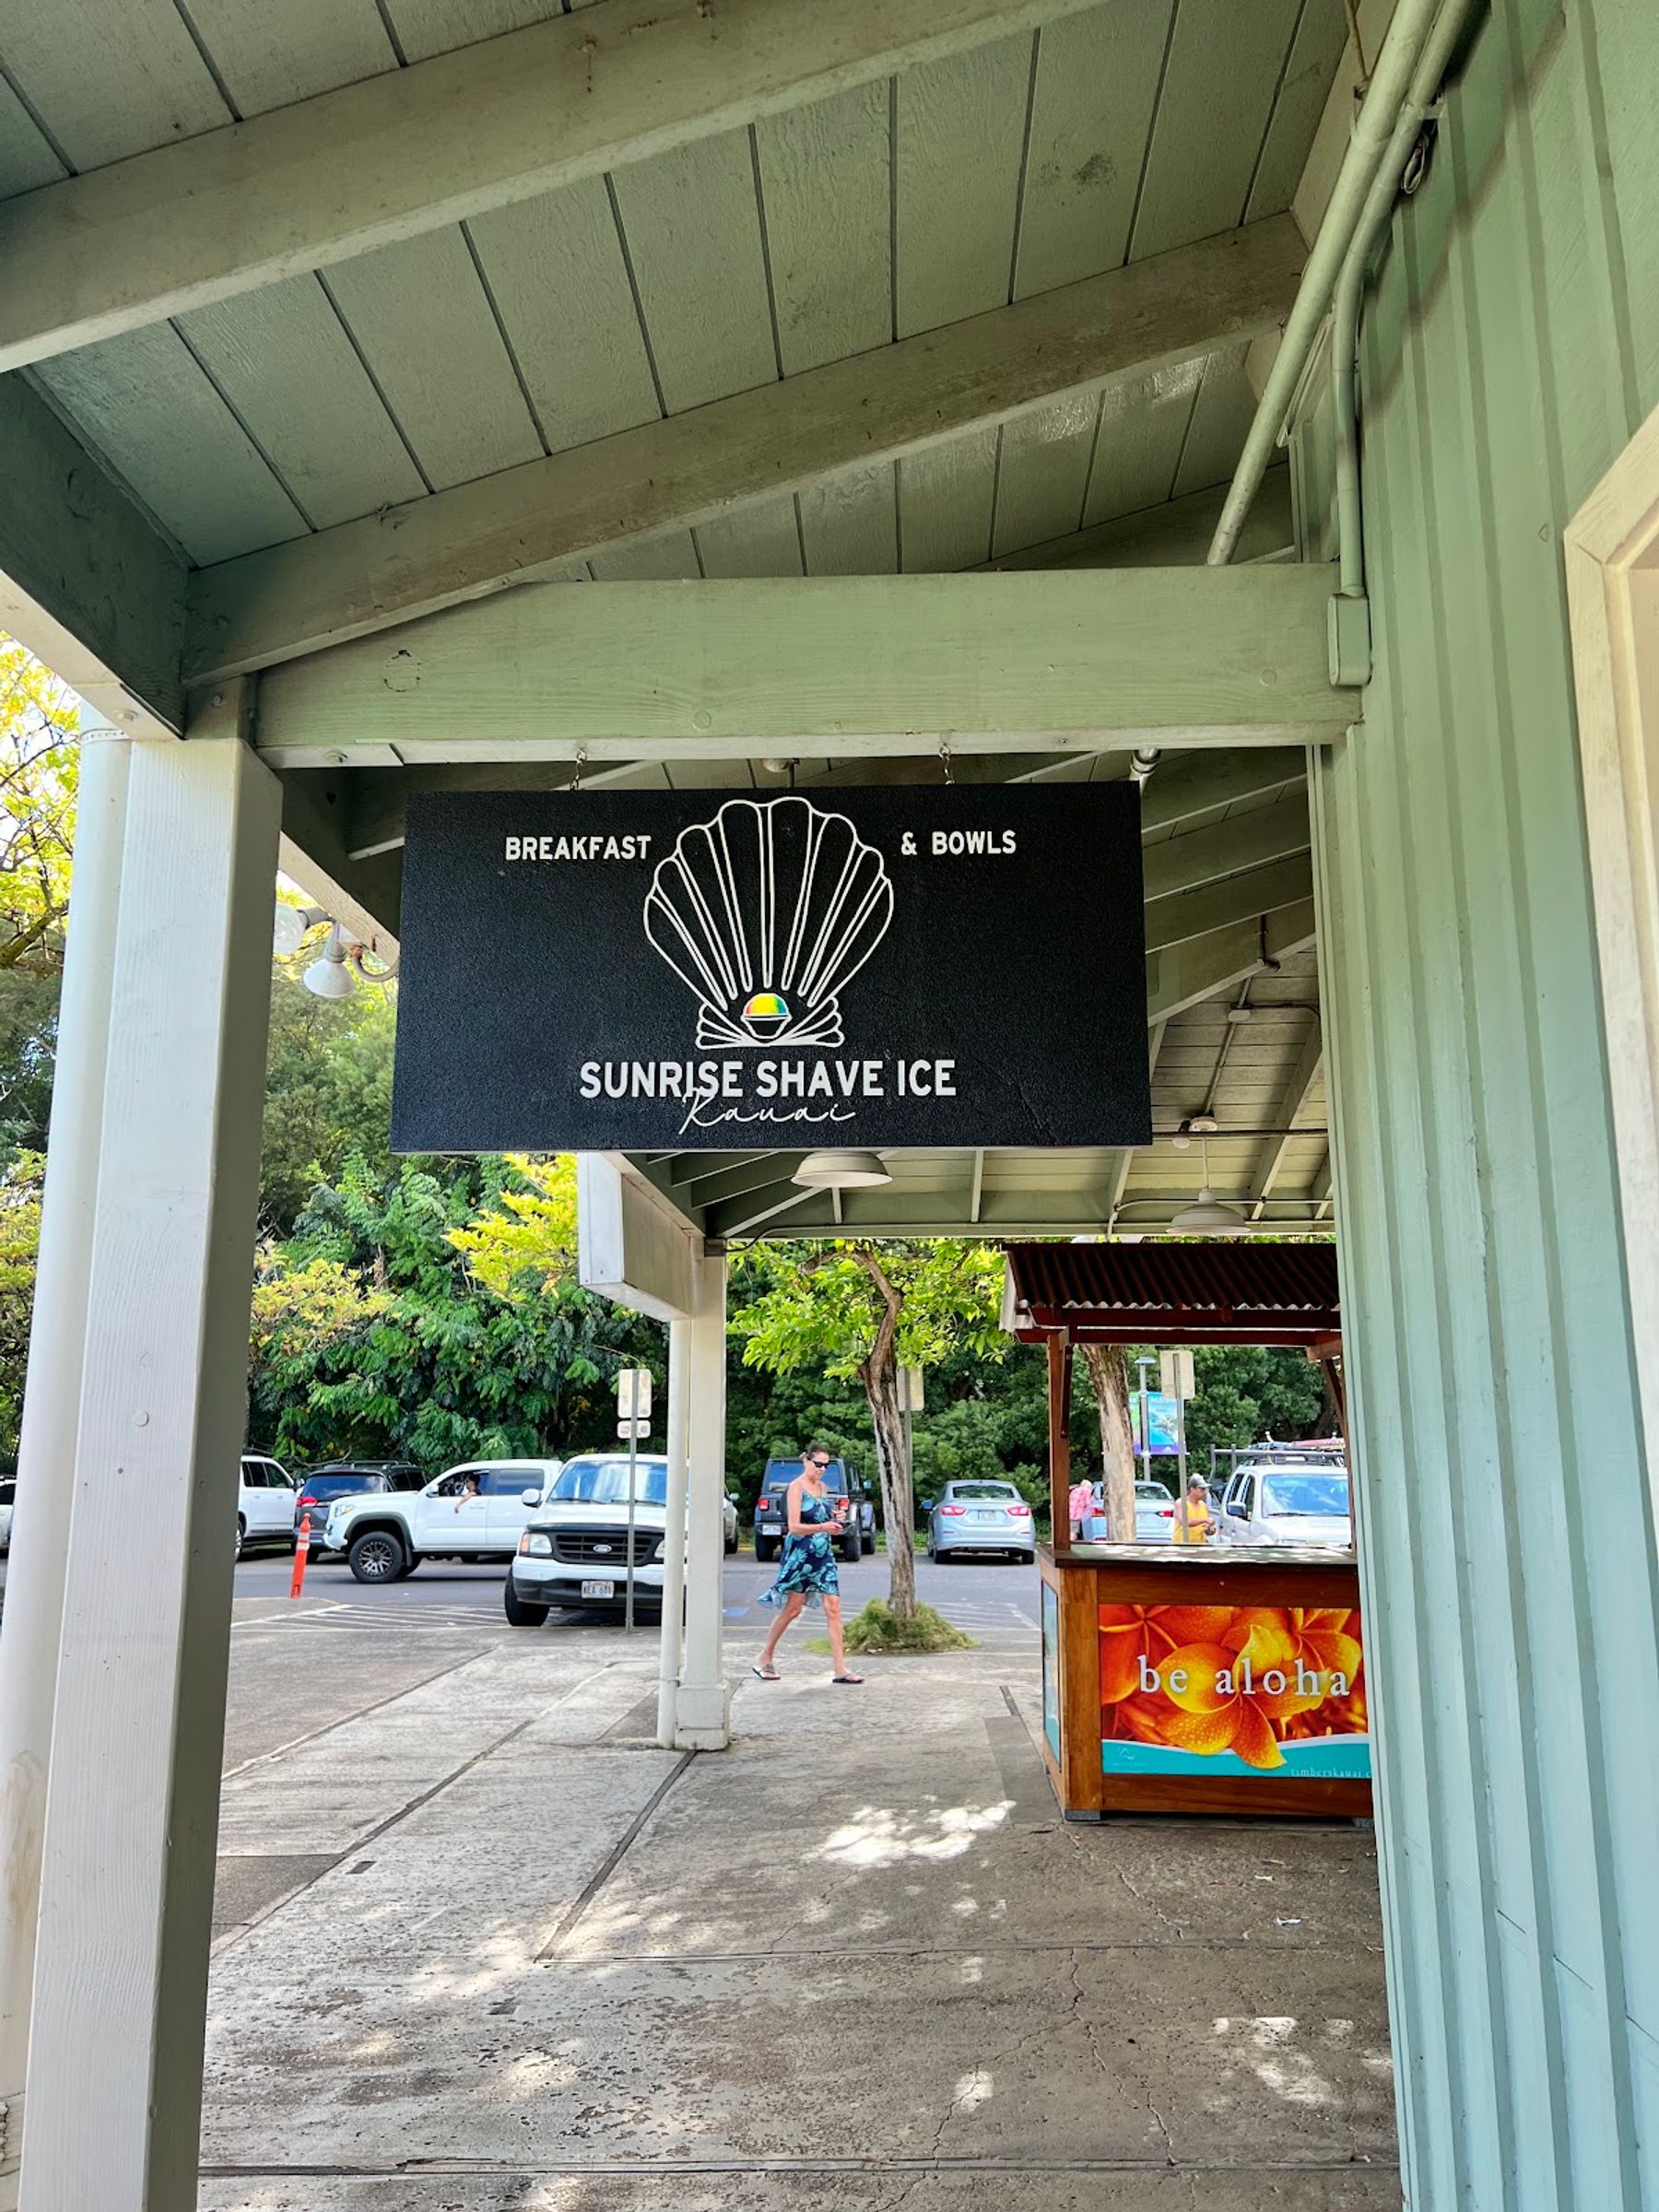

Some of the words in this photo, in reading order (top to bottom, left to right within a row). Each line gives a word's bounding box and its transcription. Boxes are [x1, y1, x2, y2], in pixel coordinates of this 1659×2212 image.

[505, 835, 653, 861] BREAKFAST
[900, 831, 918, 855] &
[932, 830, 1018, 855] BOWLS
[579, 1060, 744, 1099] SUNRISE
[756, 1059, 886, 1098] SHAVE
[898, 1059, 957, 1097] ICE
[678, 1088, 856, 1135] Kauai
[1137, 1654, 1188, 1693] be
[1215, 1657, 1350, 1697] aloha
